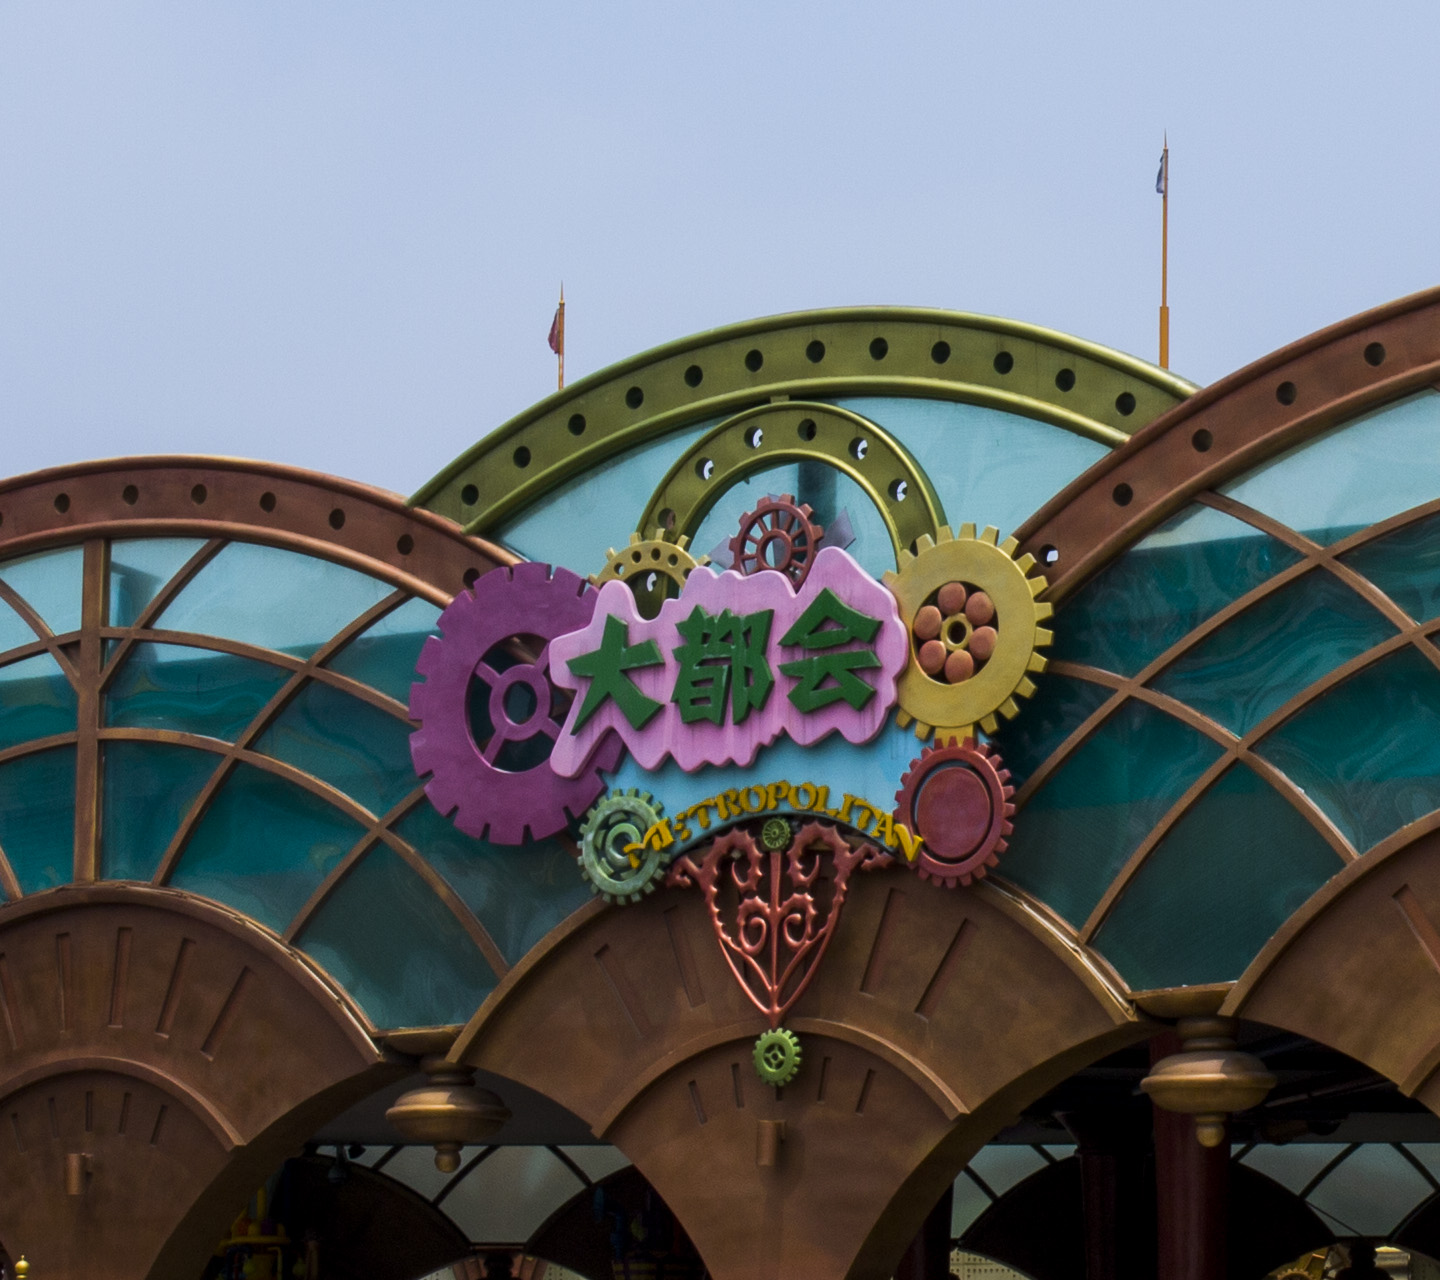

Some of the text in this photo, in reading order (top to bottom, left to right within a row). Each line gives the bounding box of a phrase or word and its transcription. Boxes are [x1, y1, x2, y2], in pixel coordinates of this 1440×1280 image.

[565, 587, 884, 736] 大都会
[623, 780, 924, 869] METROPOLITAN
